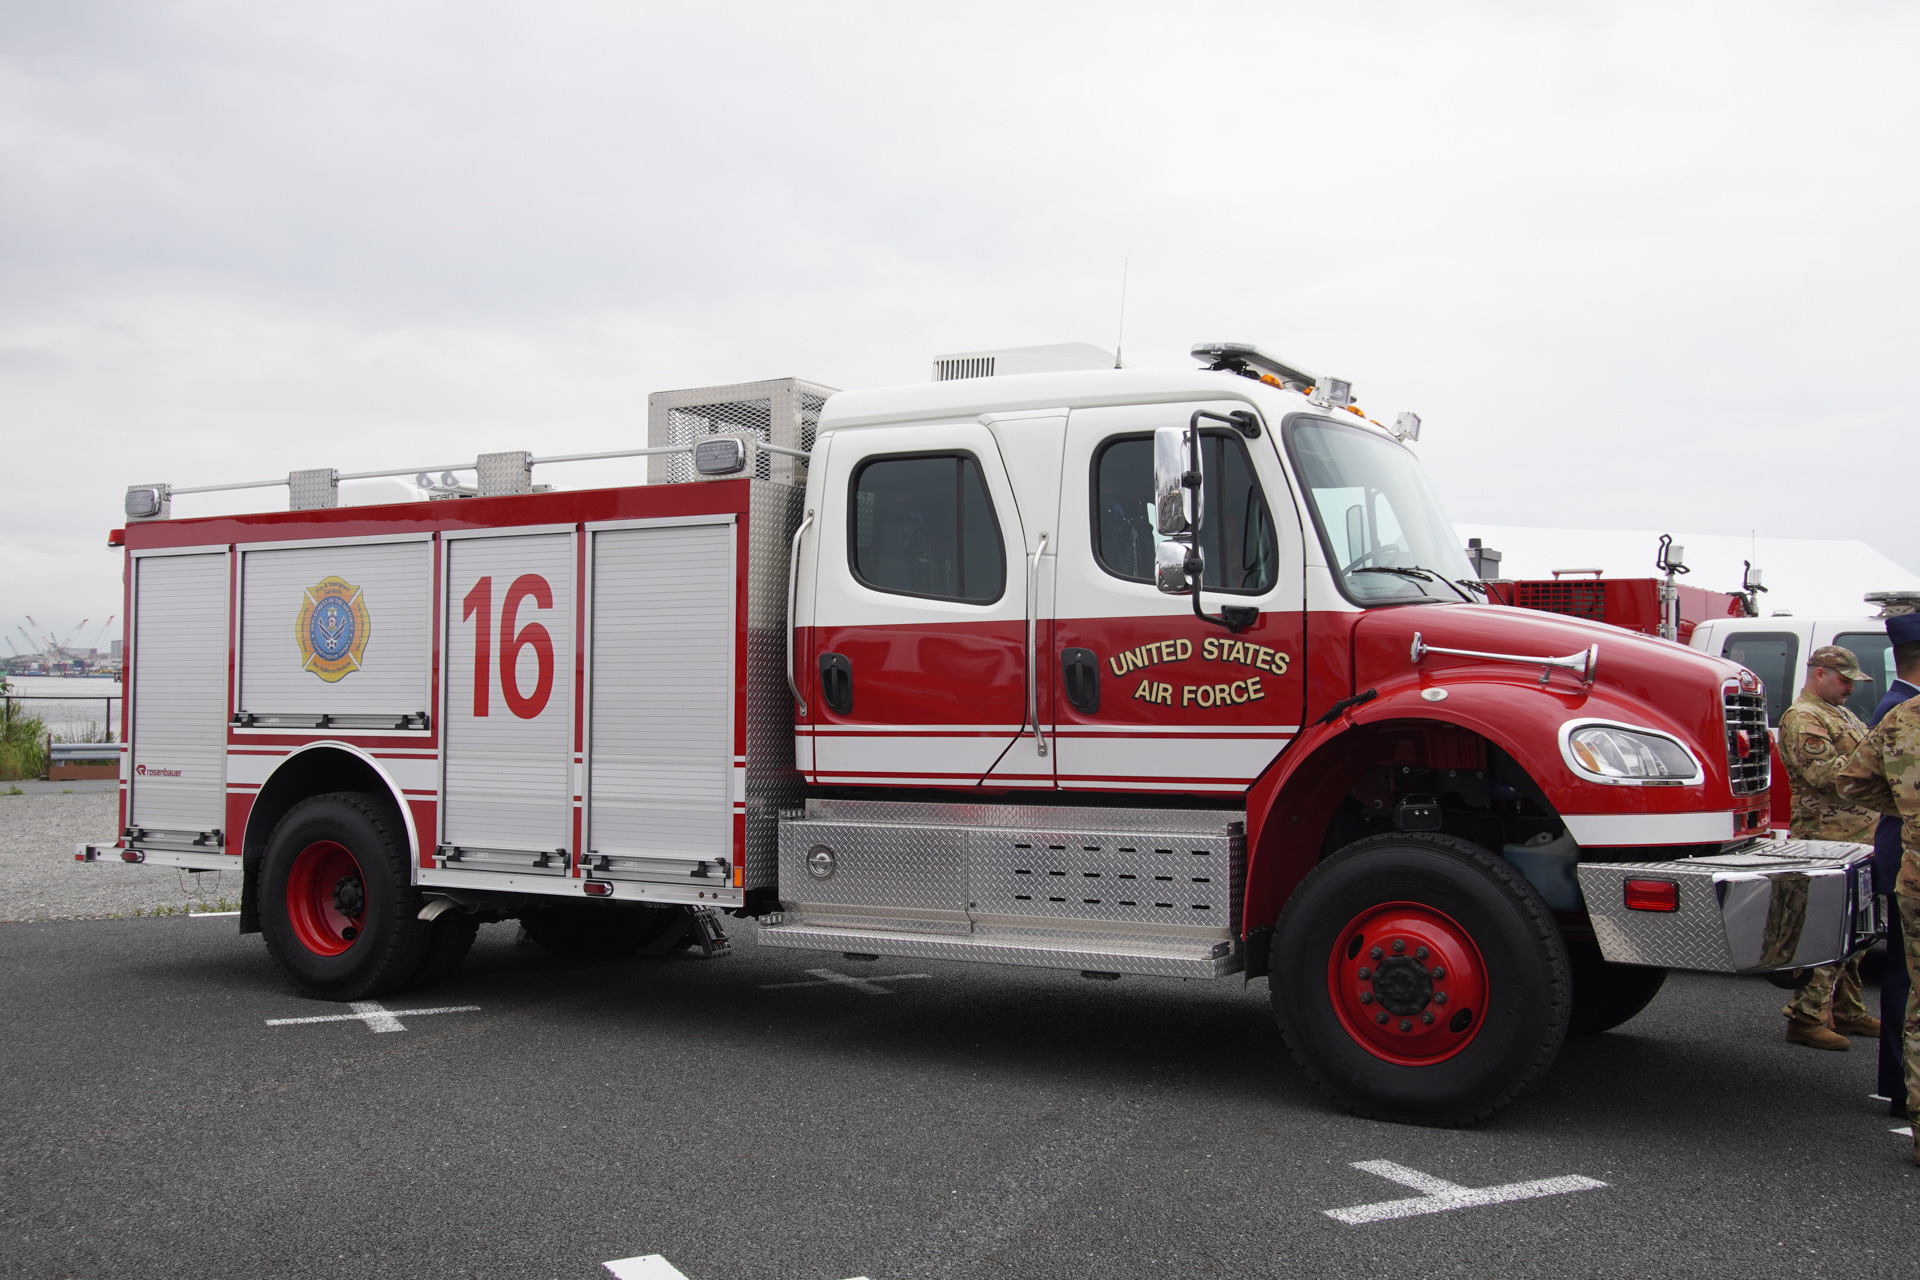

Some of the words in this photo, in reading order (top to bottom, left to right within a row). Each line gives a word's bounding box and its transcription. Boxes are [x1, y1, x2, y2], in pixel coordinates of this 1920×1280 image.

[328, 582, 351, 592] Emergency
[311, 599, 328, 631] DEPARTMENT
[463, 573, 554, 720] 16
[1108, 638, 1193, 677] UNITED
[1202, 637, 1290, 676] STATES
[336, 661, 351, 672] Perform
[1132, 679, 1173, 706] AIR
[1181, 676, 1265, 709] FORCE
[146, 768, 182, 777] rosenbauer
